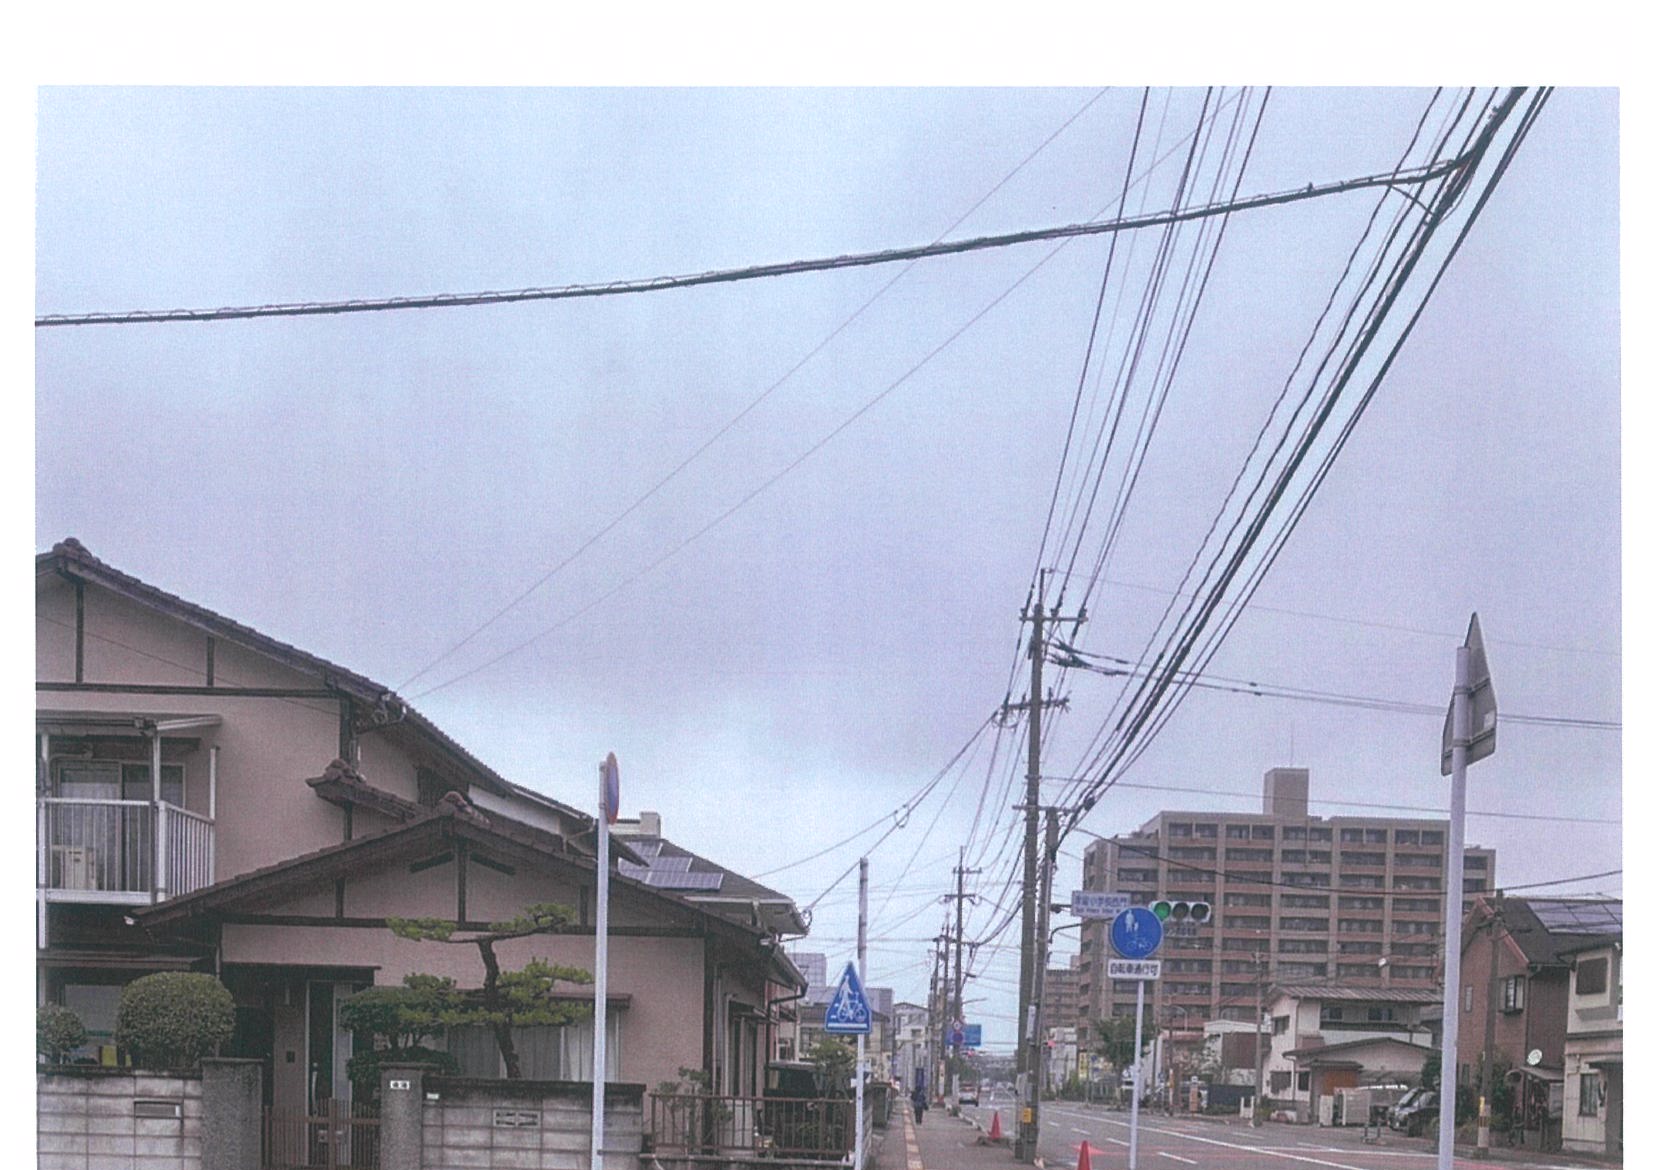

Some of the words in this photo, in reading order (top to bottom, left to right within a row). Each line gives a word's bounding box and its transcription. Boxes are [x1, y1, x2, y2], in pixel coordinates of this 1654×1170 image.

[1110, 962, 1159, 976] 自転車通行可
